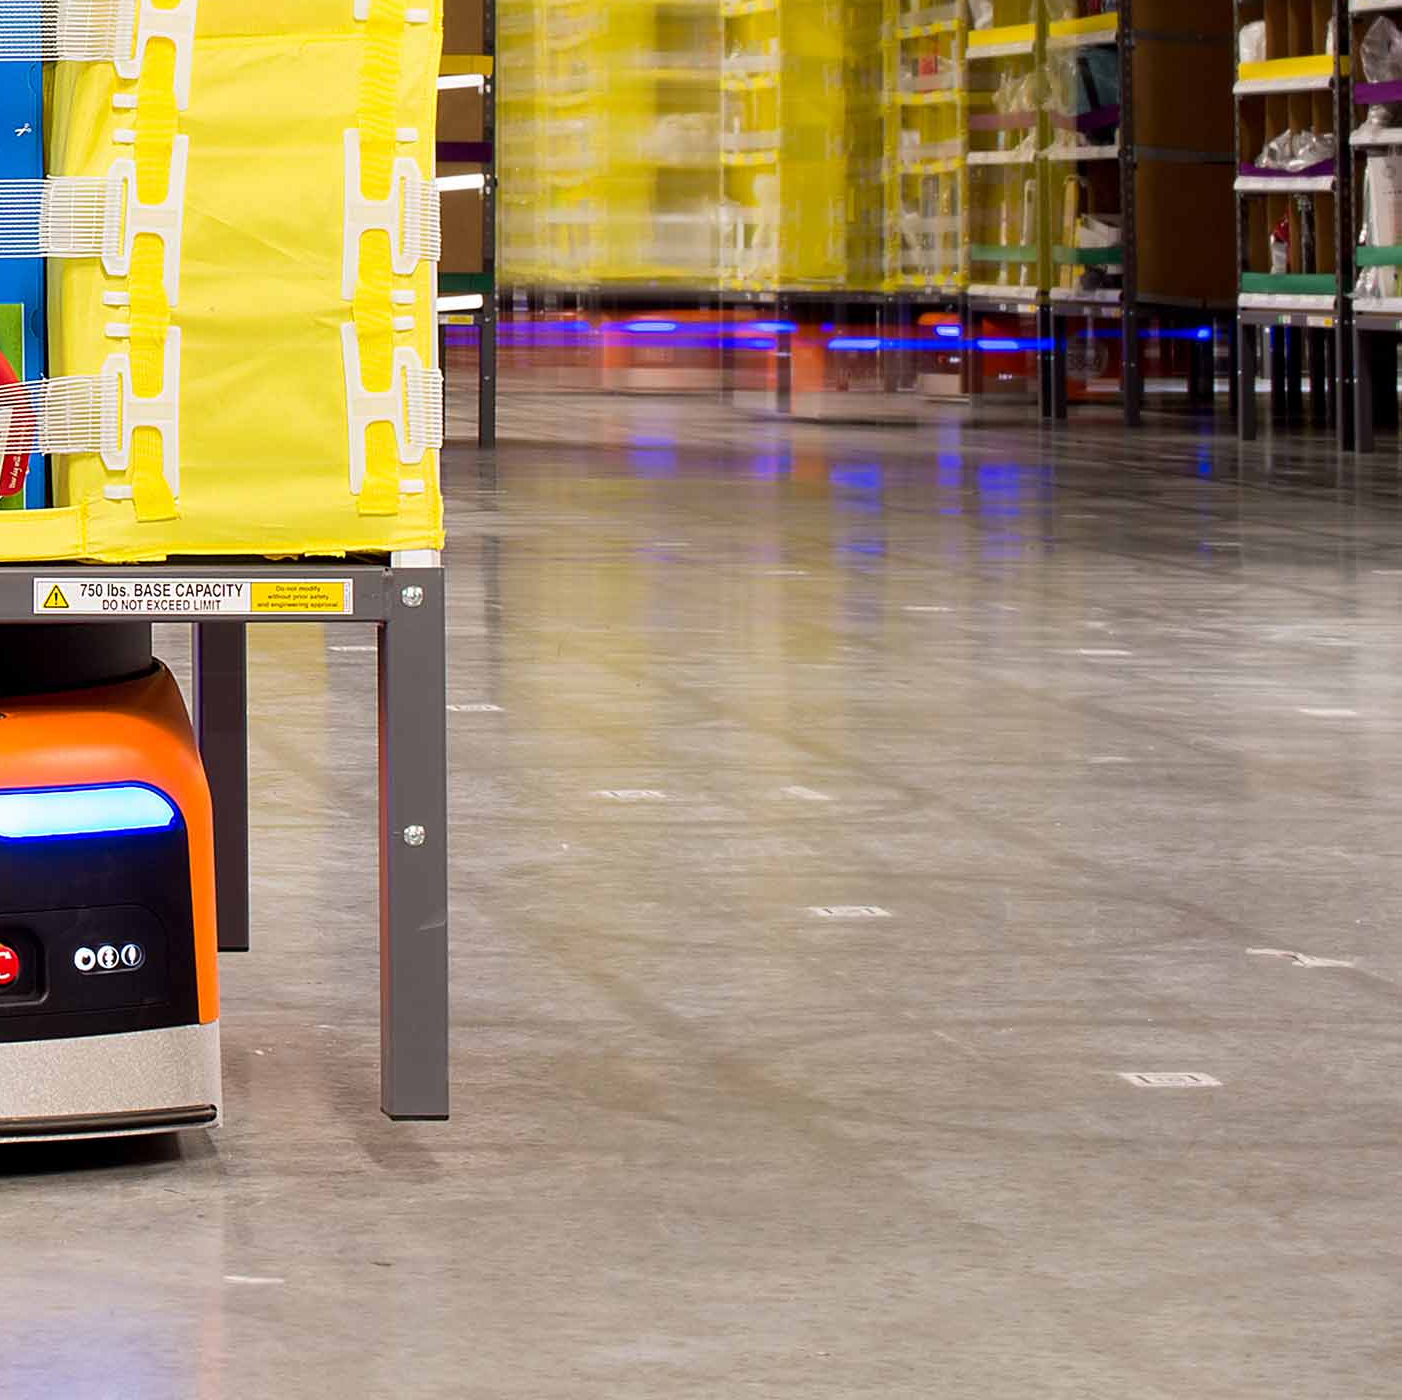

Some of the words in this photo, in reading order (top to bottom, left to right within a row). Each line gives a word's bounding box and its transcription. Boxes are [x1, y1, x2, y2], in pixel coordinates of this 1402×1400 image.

[80, 584, 103, 597] 750
[107, 584, 131, 597] lbs.
[134, 584, 172, 597] BASE
[175, 584, 243, 598] CAPACITY
[102, 600, 116, 610] DO
[118, 600, 143, 610] NOT
[147, 600, 190, 610] EXCEED
[194, 600, 221, 610] LIMIT
